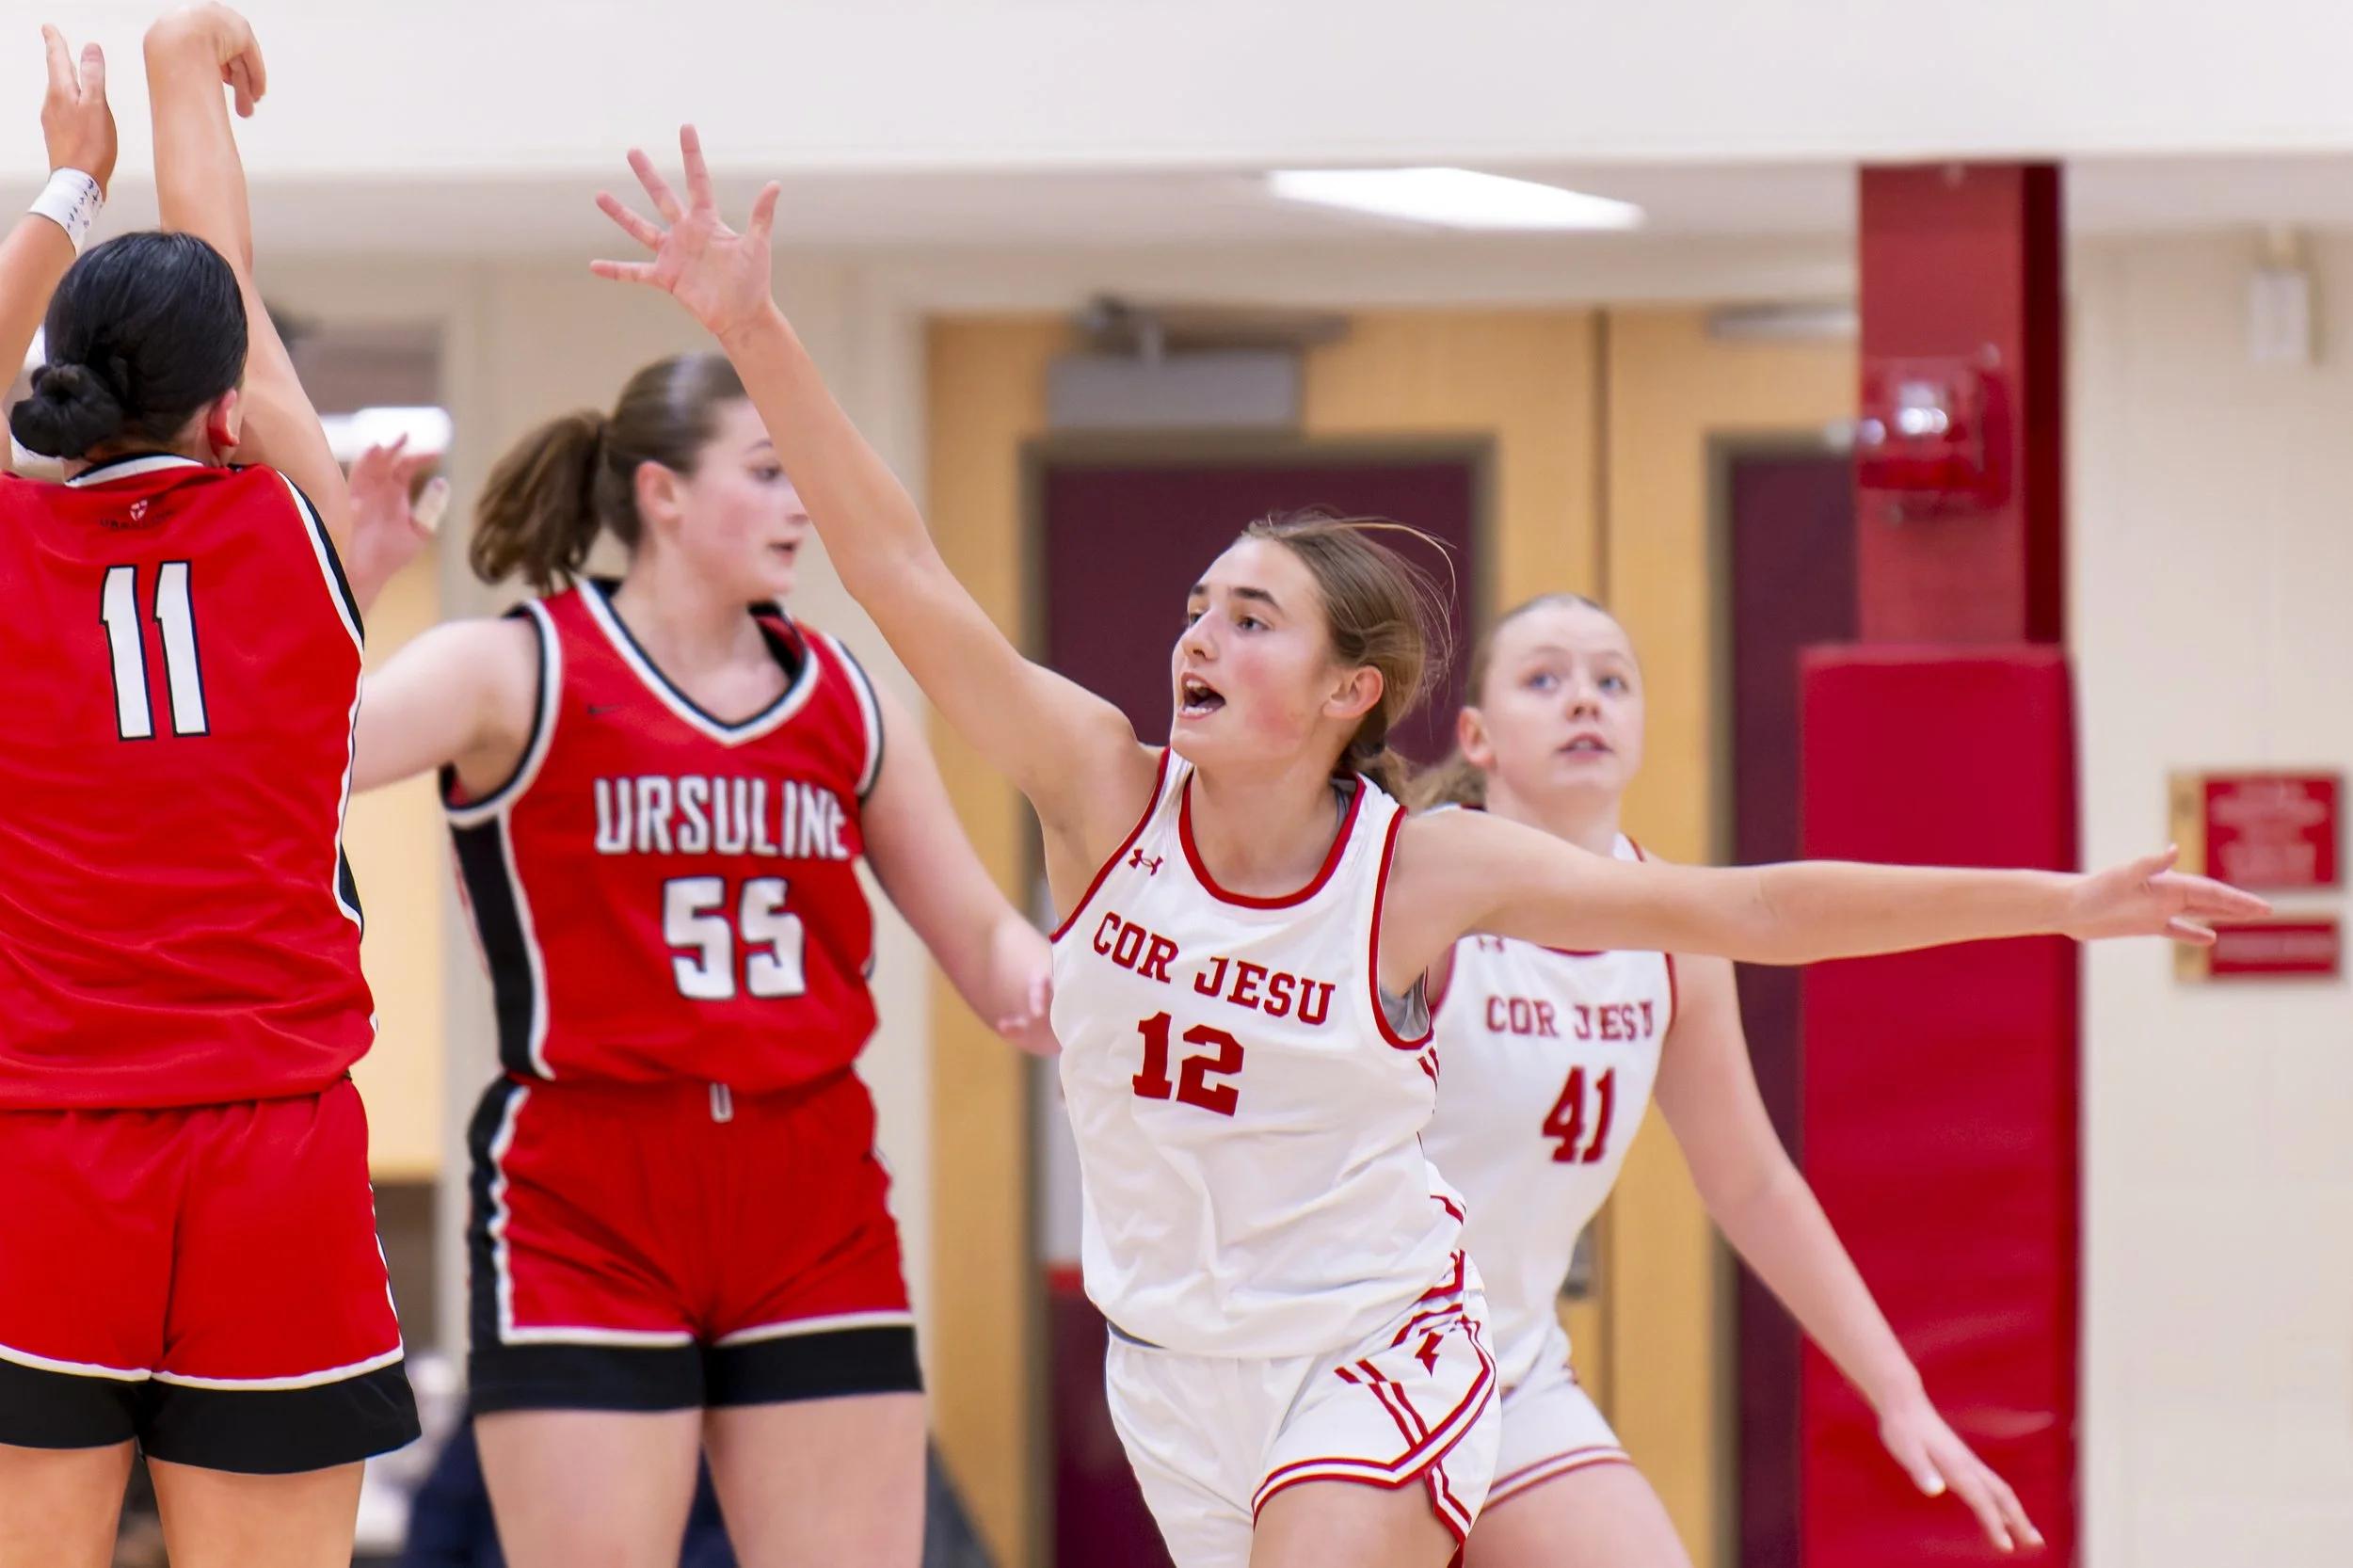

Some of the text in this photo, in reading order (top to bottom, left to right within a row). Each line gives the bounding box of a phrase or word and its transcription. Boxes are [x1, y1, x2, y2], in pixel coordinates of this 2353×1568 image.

[99, 559, 210, 742] 11
[593, 774, 849, 860] URSULINE
[662, 875, 807, 1000] 55
[1093, 910, 1337, 1026] COR JESU
[1132, 1011, 1244, 1118] 12
[1485, 994, 1559, 1039] COR
[1542, 1065, 1615, 1164] 41
